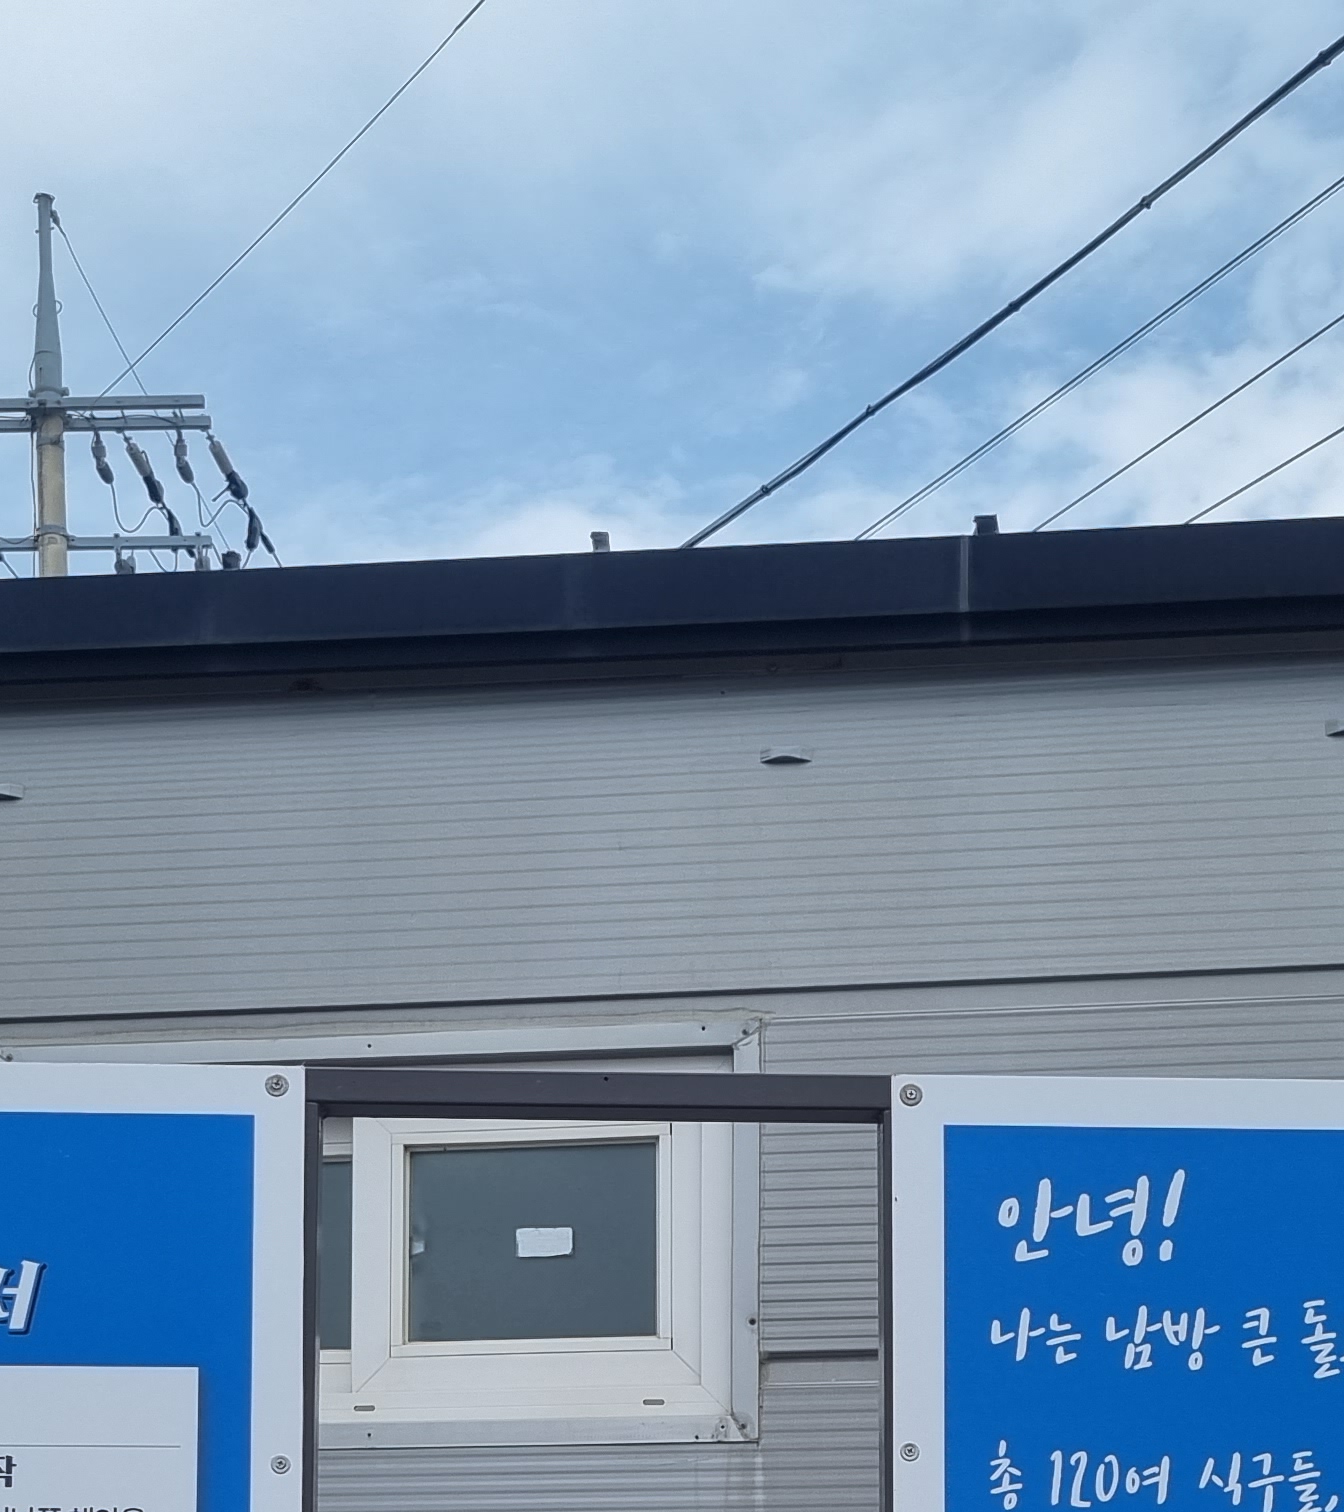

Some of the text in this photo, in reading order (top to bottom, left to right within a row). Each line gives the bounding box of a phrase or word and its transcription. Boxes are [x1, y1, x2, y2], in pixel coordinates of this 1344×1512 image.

[998, 1169, 1186, 1266] 안녕!
[991, 1308, 1081, 1363] 나는
[1106, 1305, 1220, 1370] 남방
[1241, 1308, 1277, 1366] 큰
[990, 1440, 1023, 1510] 총
[1051, 1449, 1170, 1508] 120여
